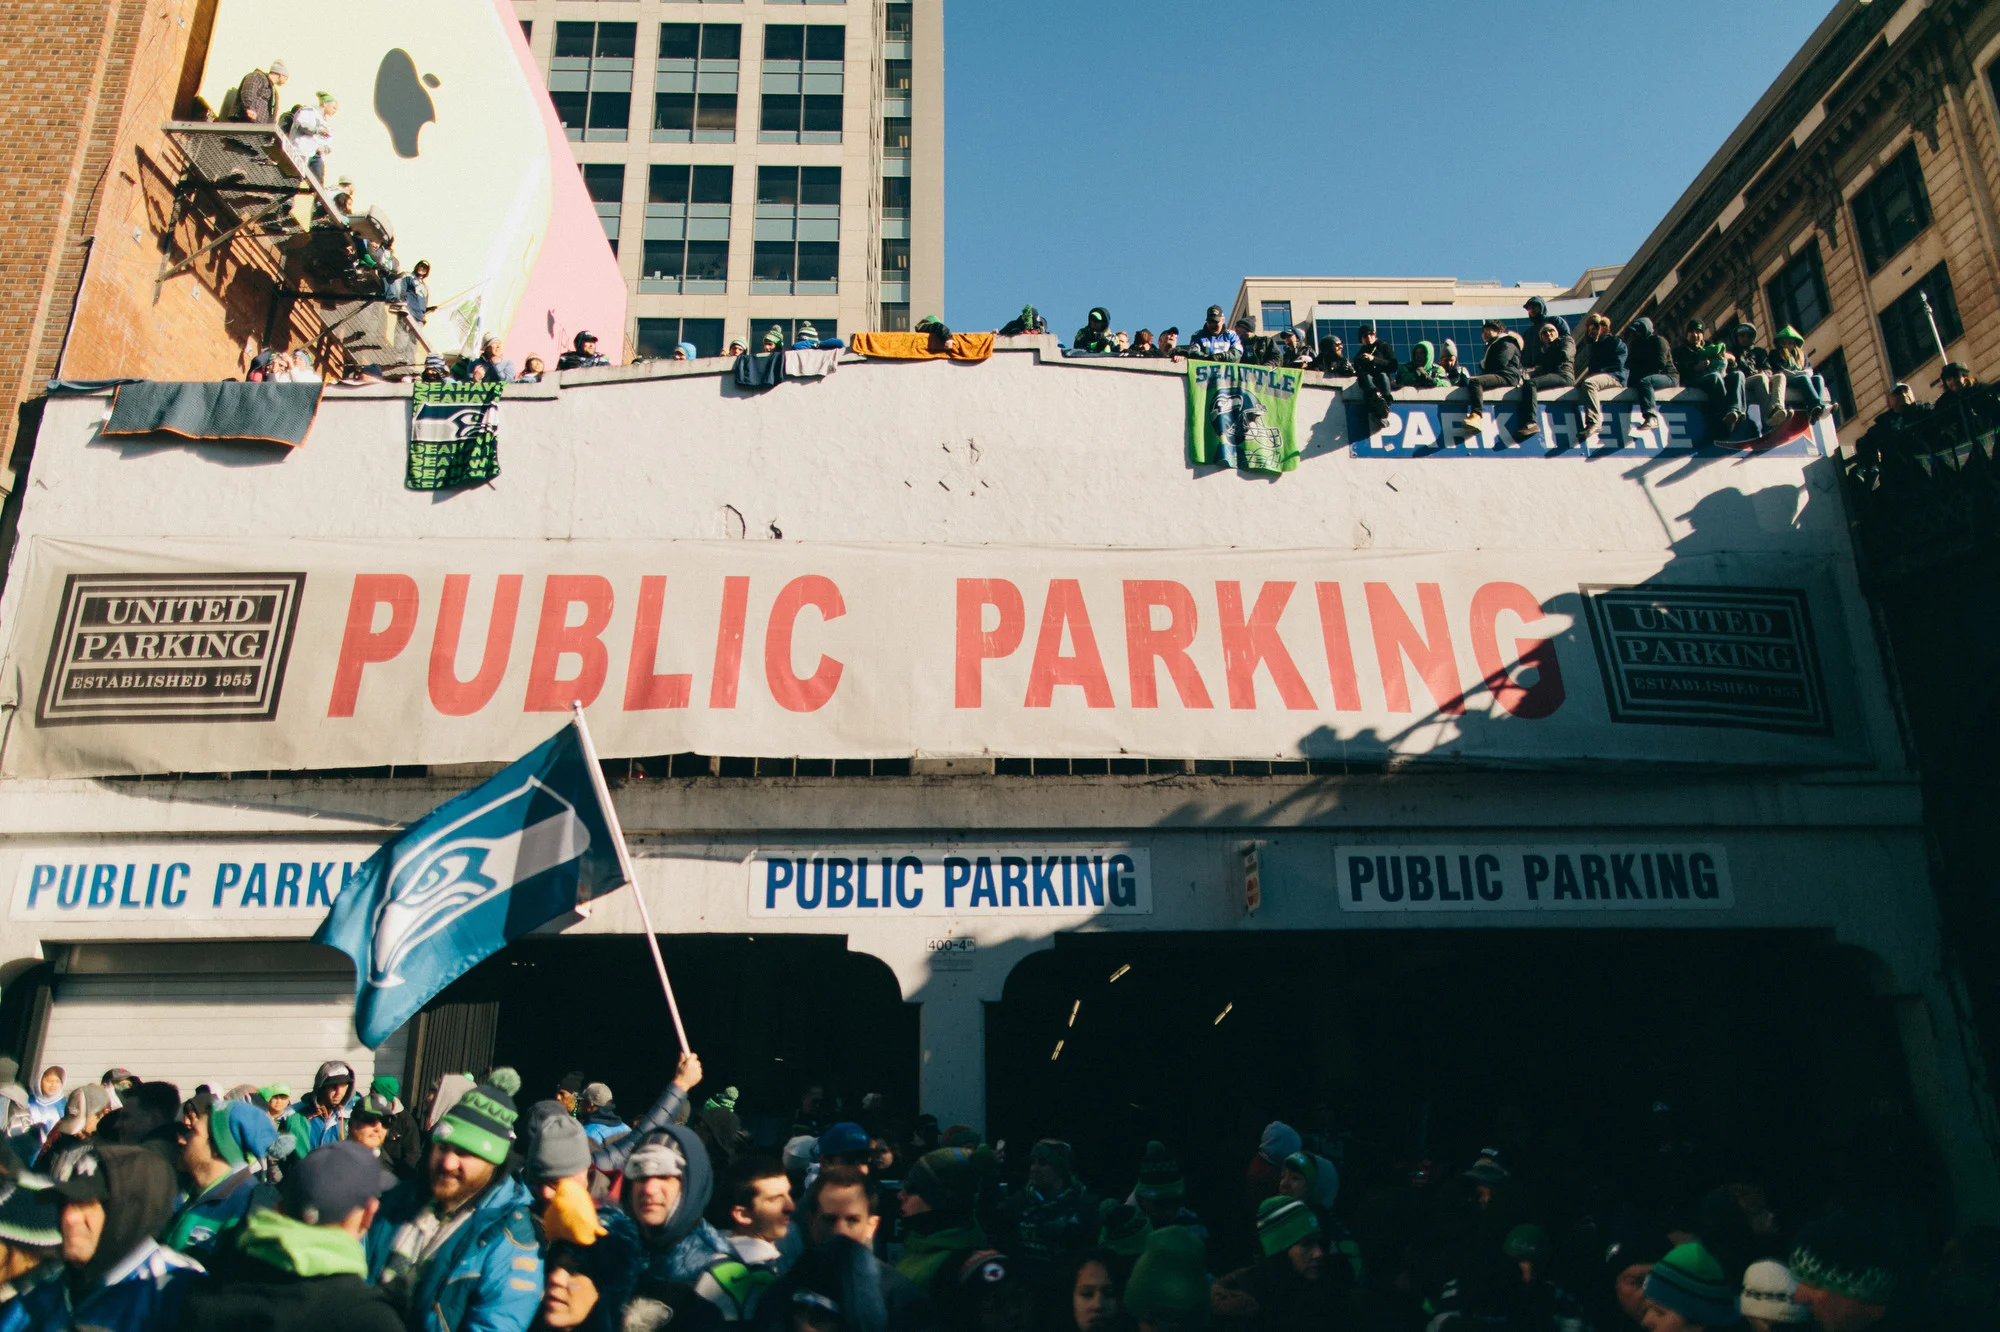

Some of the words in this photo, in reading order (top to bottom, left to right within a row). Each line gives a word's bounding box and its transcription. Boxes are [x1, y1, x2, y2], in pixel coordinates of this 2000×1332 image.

[1195, 364, 1296, 394] SEATTLE
[1367, 410, 1521, 450] PARK
[1542, 410, 1692, 450] HERE
[105, 597, 255, 624] UNITED
[1629, 606, 1773, 635] UNITED
[78, 632, 260, 660] PARKING
[326, 573, 847, 718] PUBLIC
[954, 577, 1566, 720] PARKING
[1623, 640, 1794, 670] PARKING
[70, 674, 208, 690] ESTABLISHED
[213, 673, 253, 687] 1955
[1633, 676, 1761, 697] ESTABLISHED
[26, 862, 192, 911] PUBLIC
[211, 861, 368, 909] PARKI
[765, 855, 924, 910] PUBLIC
[944, 853, 1138, 908] PARKING
[1347, 853, 1504, 902] PUBLIC
[1522, 851, 1721, 900] PARKING
[927, 939, 975, 951] 400-4th
